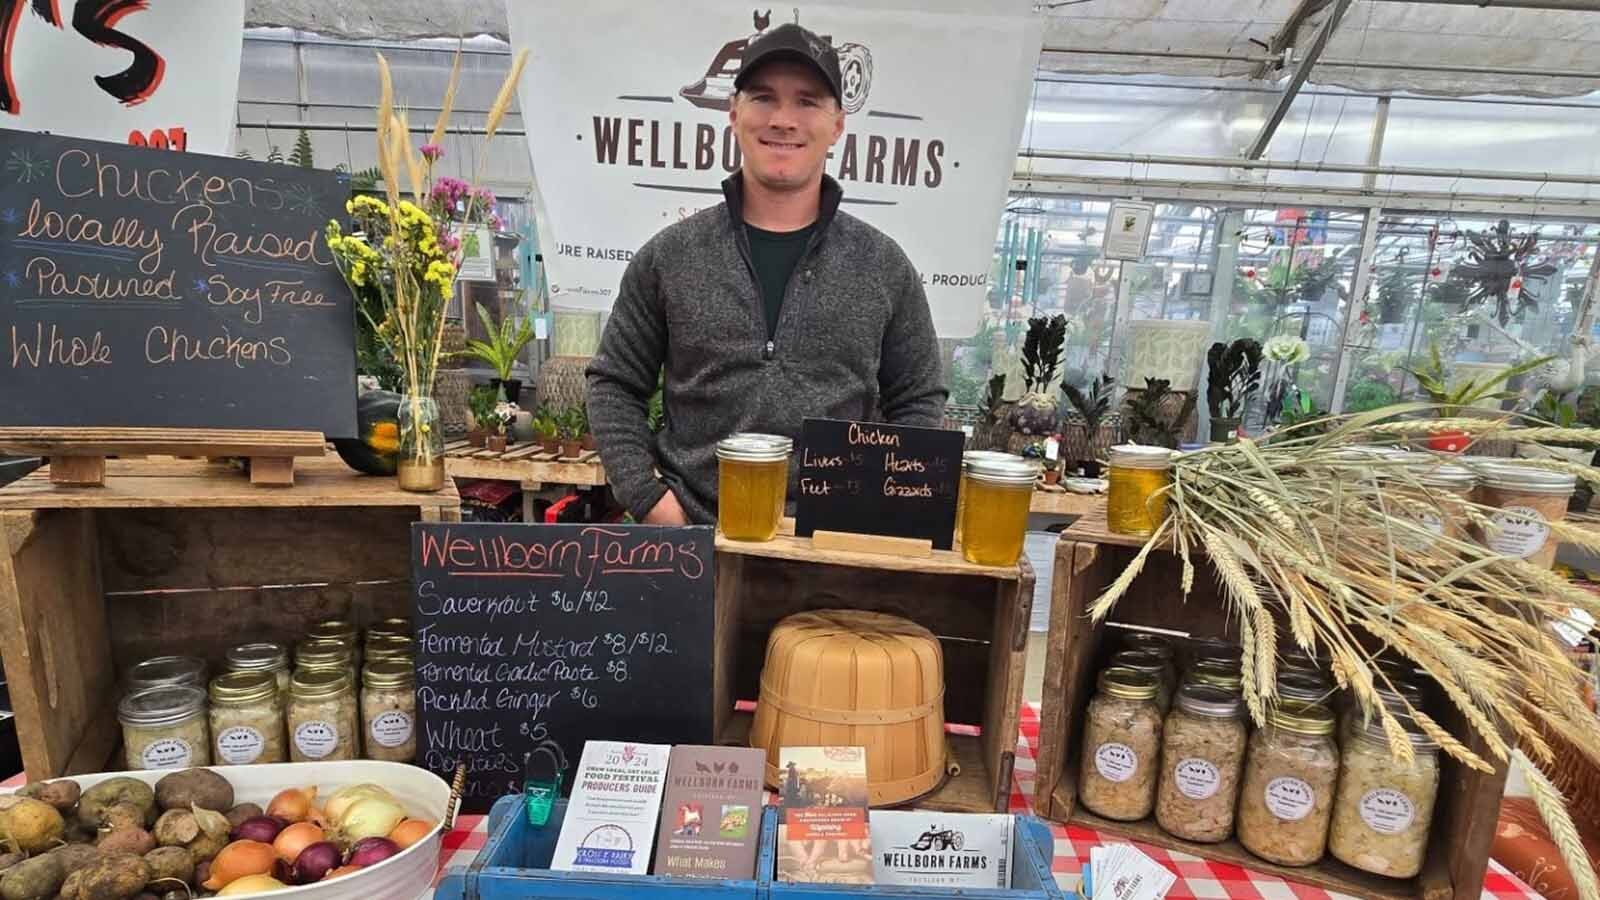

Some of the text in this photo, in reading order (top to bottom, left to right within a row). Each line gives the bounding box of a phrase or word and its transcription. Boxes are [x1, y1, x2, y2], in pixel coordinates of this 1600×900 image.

[593, 115, 945, 188] WELLBO ARMS
[56, 149, 286, 209] Chickens
[19, 199, 333, 274] locally Raised
[207, 274, 265, 324] Soy
[266, 281, 336, 305] Free
[12, 322, 292, 369] Whole Chickens
[848, 423, 900, 447] Chicken
[804, 448, 843, 468] Livers
[885, 452, 926, 473] Hearts
[801, 477, 832, 495] Feet
[884, 476, 932, 497] Gizzards
[422, 528, 704, 589] Wellborn Farms
[418, 580, 541, 623] Sauerkraut
[417, 623, 507, 656] Fermented
[418, 662, 492, 683] Fermented
[495, 662, 547, 681] Garlic
[547, 659, 600, 681] Paste
[418, 686, 490, 713] Pickled
[496, 687, 560, 721] Ginger
[426, 720, 504, 752] Wheat
[519, 721, 549, 741] $5
[582, 780, 657, 793] PRODUCERS GUIDE
[584, 772, 660, 782] FOOD FESTIVAL
[668, 855, 727, 869] What Makes
[883, 853, 988, 869] WELLBORN FARMS
